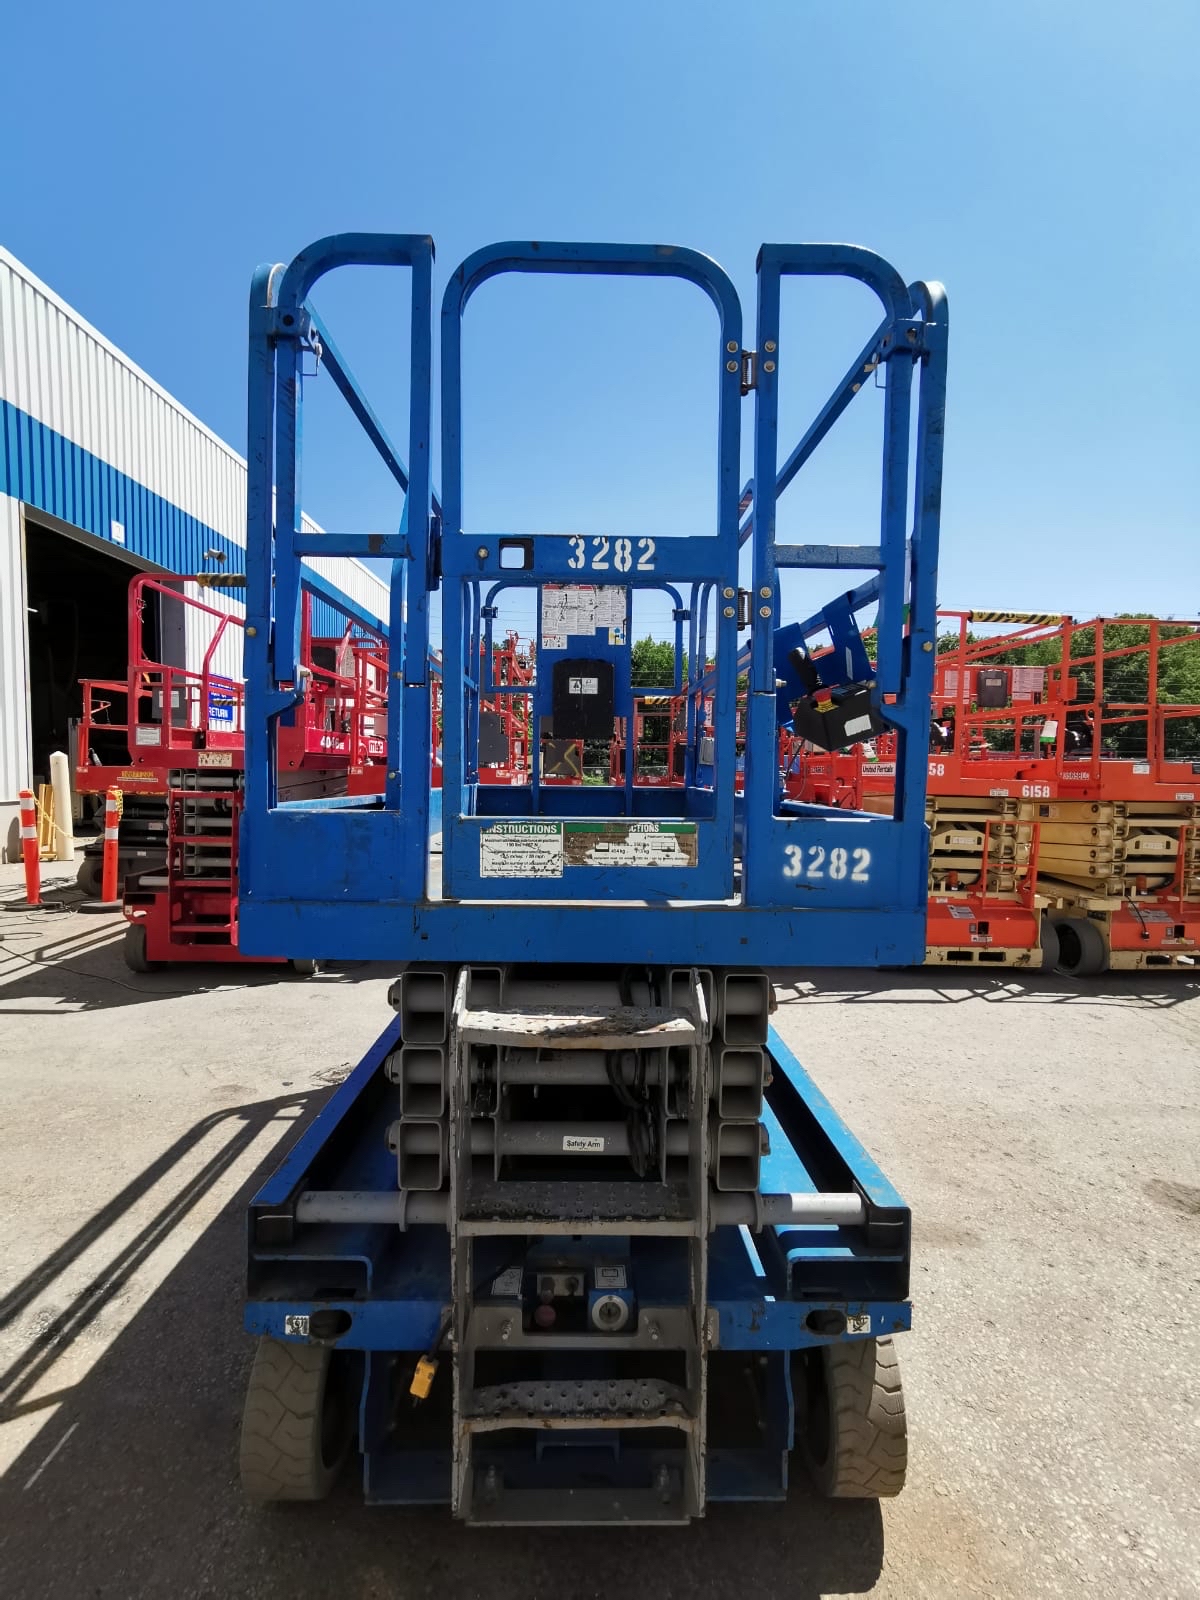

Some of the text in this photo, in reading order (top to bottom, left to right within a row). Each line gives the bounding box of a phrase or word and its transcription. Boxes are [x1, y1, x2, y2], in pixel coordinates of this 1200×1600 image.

[568, 536, 656, 572] 3282
[862, 765, 894, 774] United Rentals
[928, 762, 945, 777] 58
[1022, 784, 1050, 798] 6158
[486, 824, 557, 834] NSTRUCTIONS
[783, 845, 871, 881] 3282
